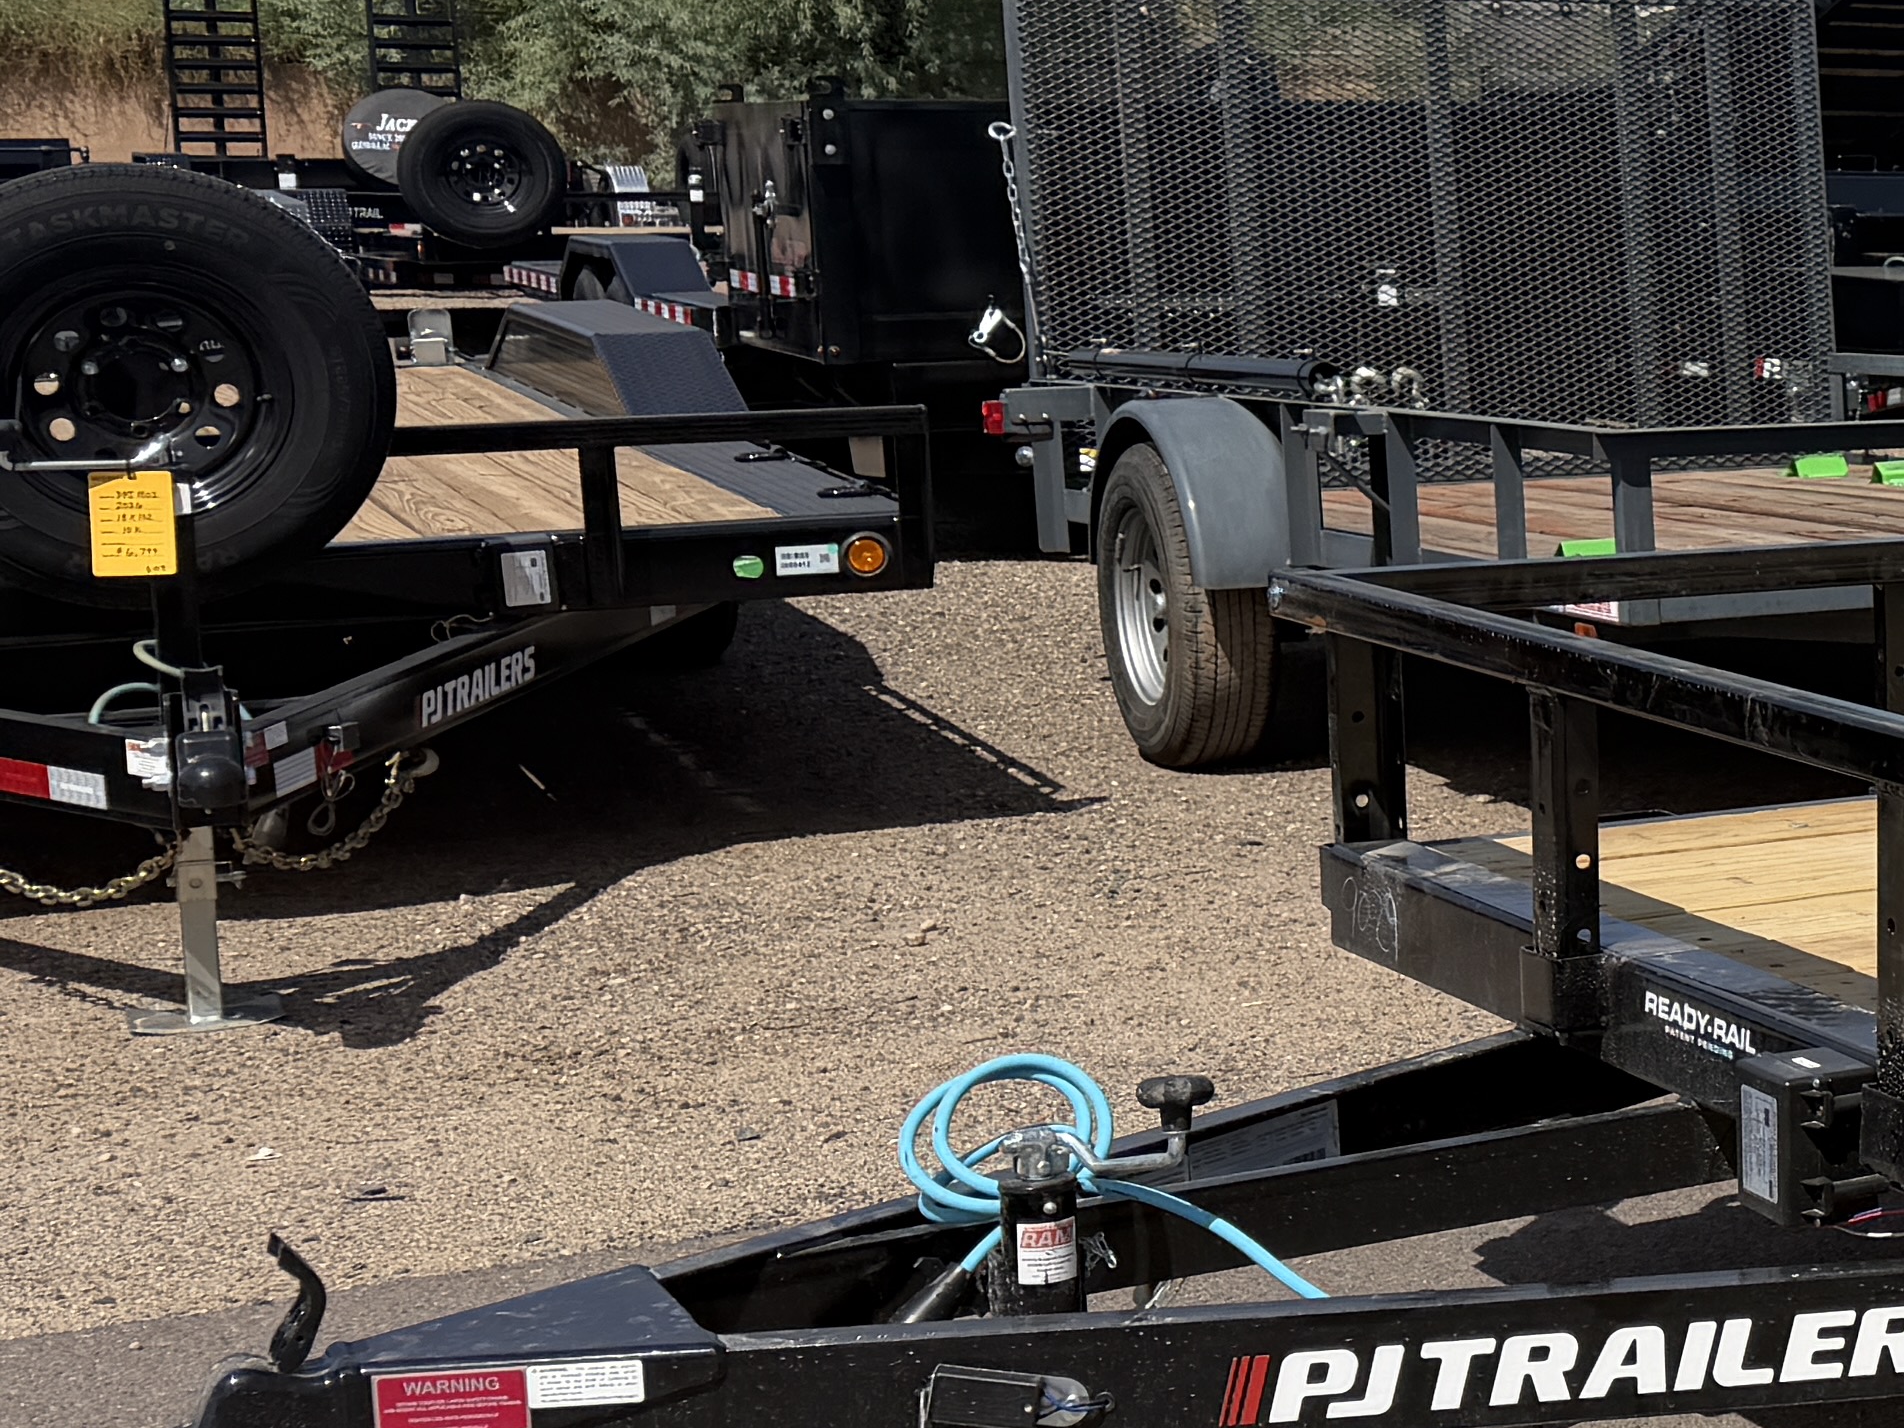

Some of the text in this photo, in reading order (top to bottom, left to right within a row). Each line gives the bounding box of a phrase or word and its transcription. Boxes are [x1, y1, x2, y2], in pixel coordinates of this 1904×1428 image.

[3, 204, 250, 247] TASKMASTER
[422, 645, 536, 728] PJ TRAILERS
[403, 1376, 500, 1397] WARNING
[1268, 1344, 1404, 1424] PJ
